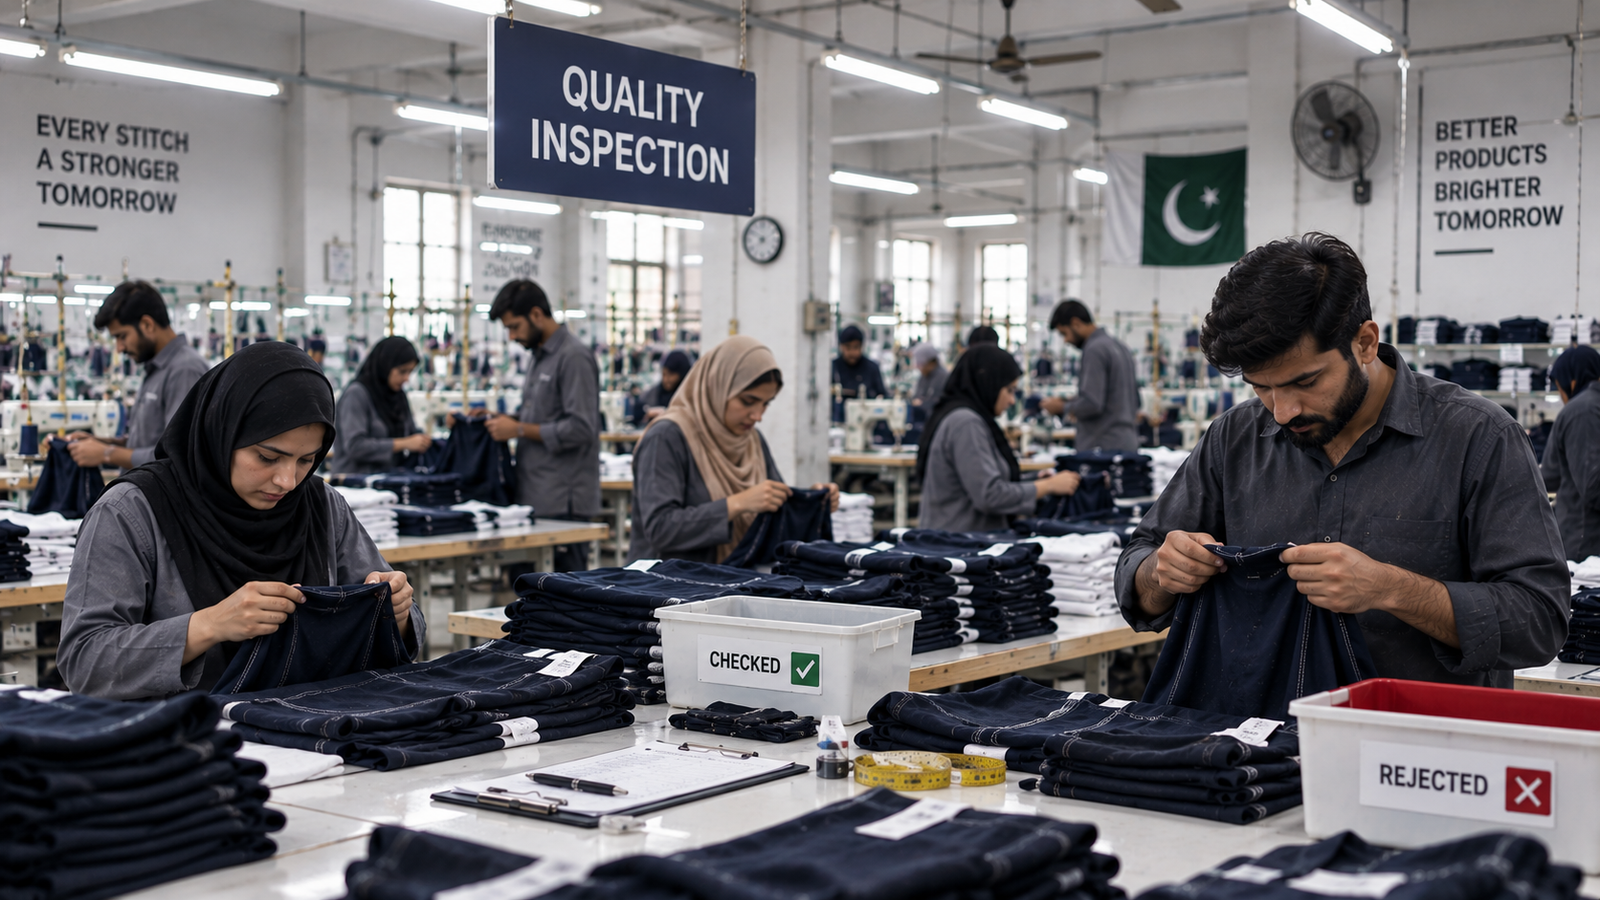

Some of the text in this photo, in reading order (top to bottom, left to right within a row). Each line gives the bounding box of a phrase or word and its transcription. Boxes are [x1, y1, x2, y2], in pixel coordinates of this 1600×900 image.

[562, 65, 704, 128] QUALITY
[36, 113, 189, 154] EVERY STITCH
[1436, 115, 1518, 142] BETTER
[36, 147, 180, 183] A STRONGER
[531, 118, 729, 185] INSPECTION
[1435, 143, 1548, 171] PRODUCTS
[36, 180, 177, 215] TOMORROW
[1435, 176, 1542, 202] BRIGHTER
[1434, 204, 1564, 232] TOMORROW
[709, 650, 781, 674] CHECKED
[1379, 763, 1489, 796] REJECTED
